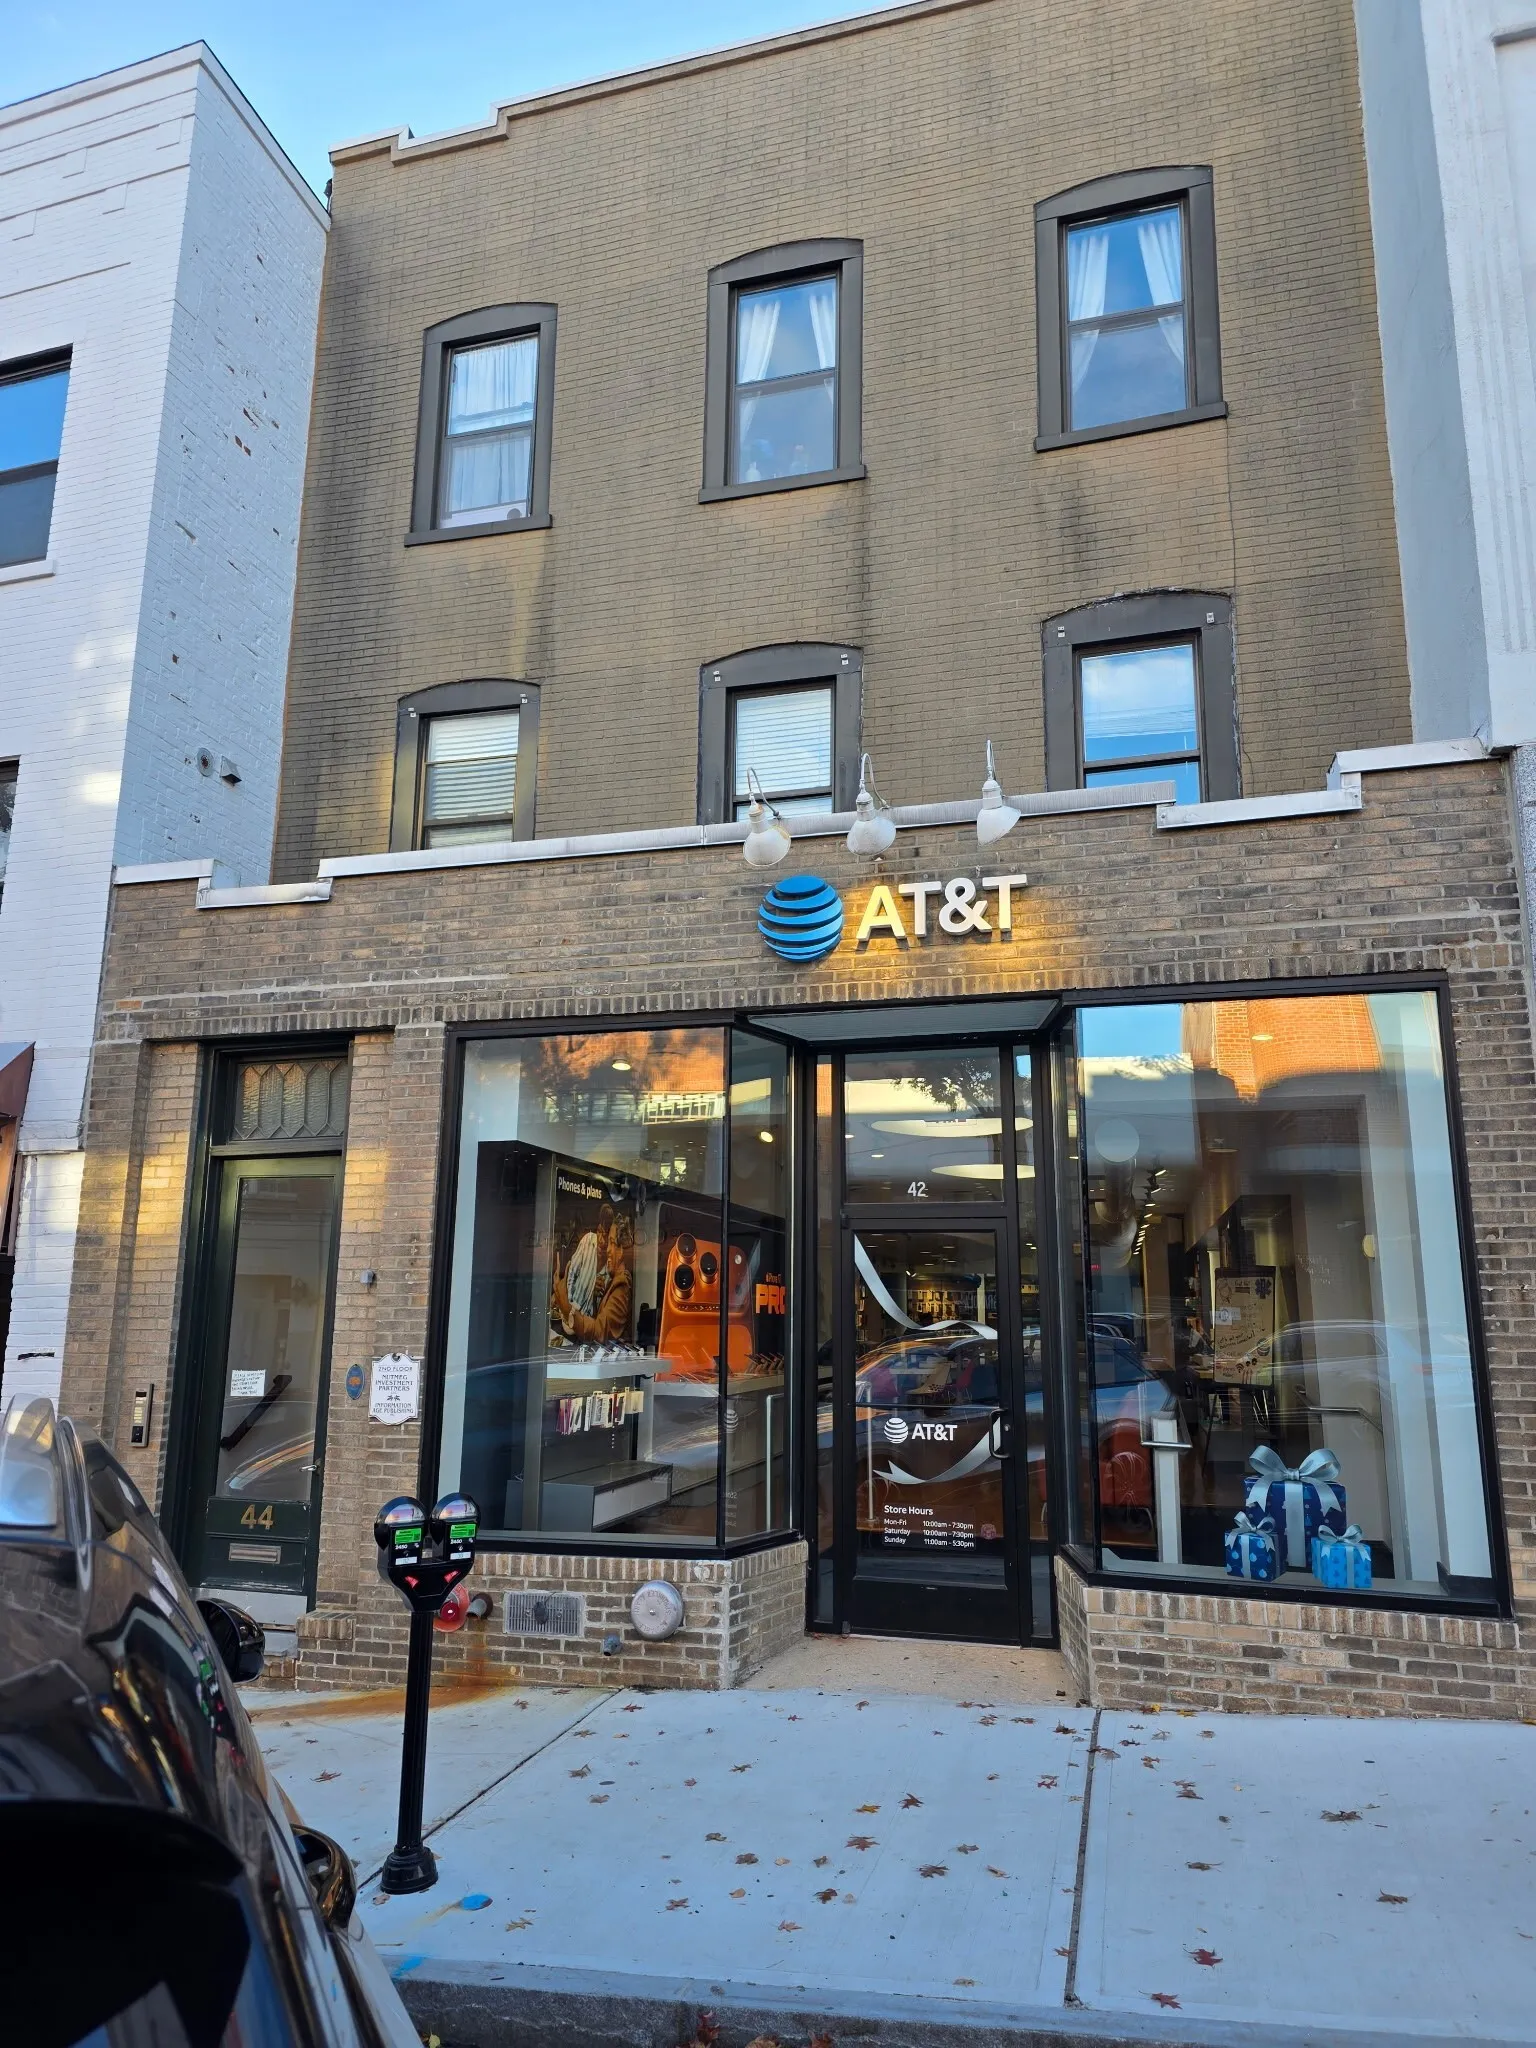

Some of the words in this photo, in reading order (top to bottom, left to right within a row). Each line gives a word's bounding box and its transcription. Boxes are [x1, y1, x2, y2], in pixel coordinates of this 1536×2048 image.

[856, 873, 1028, 942] AT&T
[557, 1176, 581, 1195] Phones
[580, 1182, 587, 1196] &
[586, 1185, 603, 1200] plans
[907, 1181, 929, 1197] 42
[911, 1422, 958, 1442] AT&T
[240, 1503, 274, 1531] 44
[884, 1504, 907, 1514] Store
[908, 1505, 934, 1516] Hours
[883, 1518, 907, 1526] Mon-Fri
[923, 1520, 948, 1528] 10:00am
[952, 1522, 974, 1531] 7:30pm
[884, 1527, 911, 1537] Saturday
[923, 1529, 948, 1537] 10:00am
[952, 1530, 974, 1540] 7:30pm
[884, 1536, 906, 1545] Sunday
[924, 1538, 948, 1546] 11:00am
[952, 1540, 975, 1548] 5:30pm
